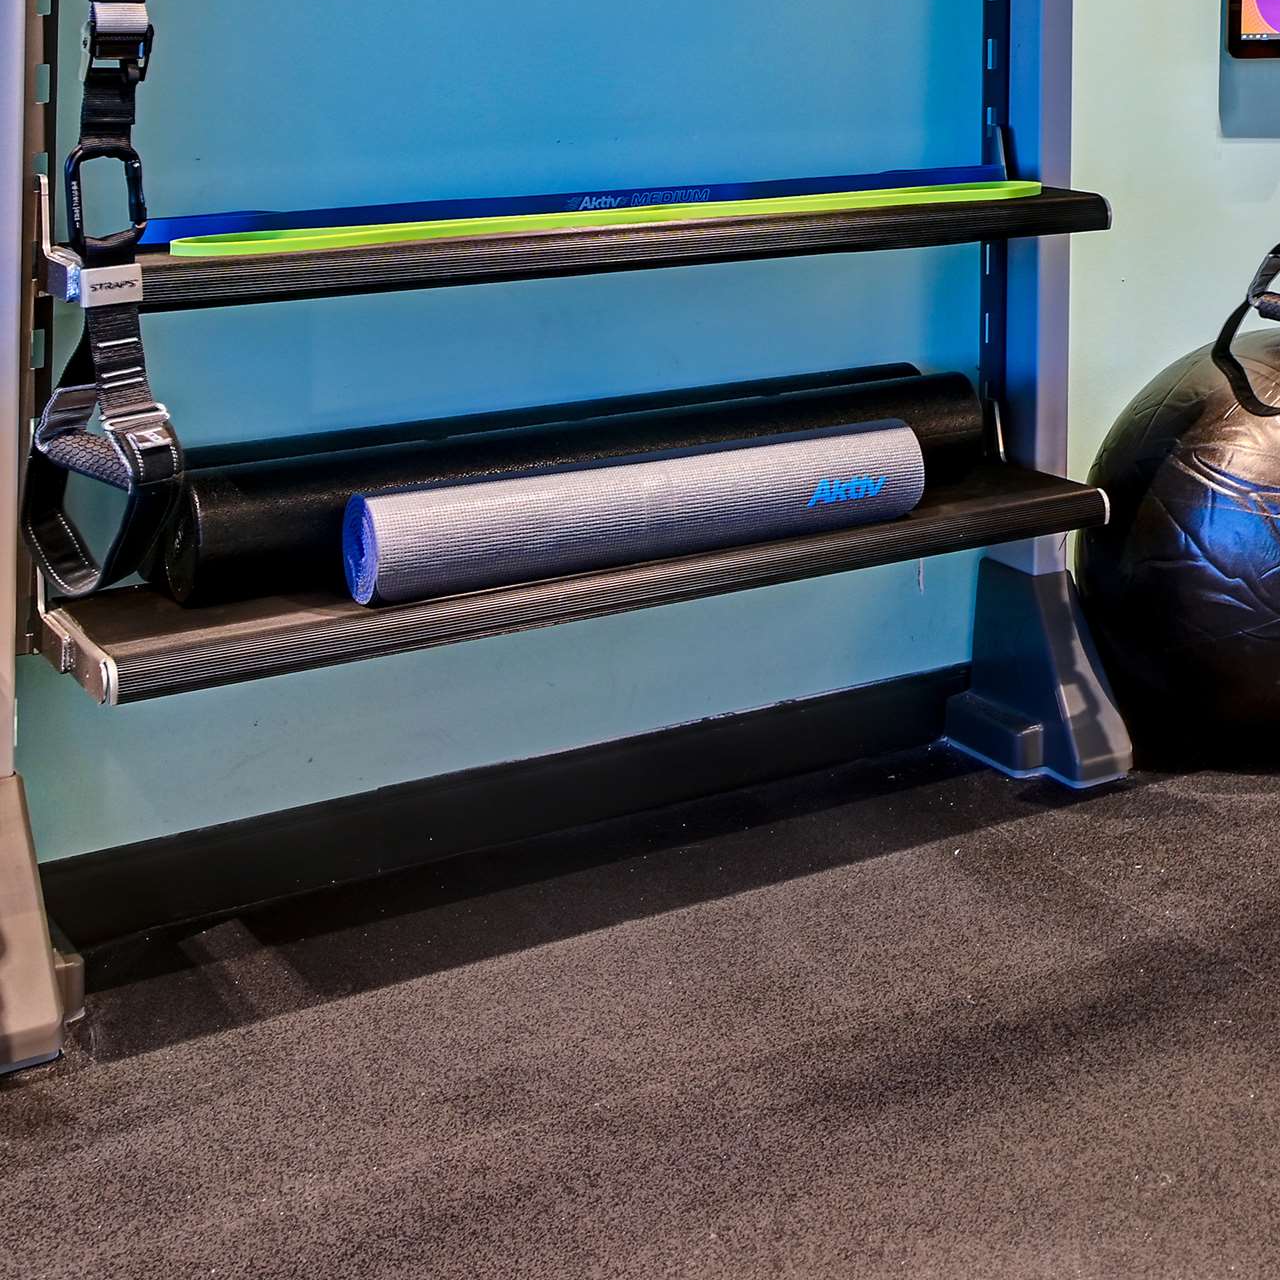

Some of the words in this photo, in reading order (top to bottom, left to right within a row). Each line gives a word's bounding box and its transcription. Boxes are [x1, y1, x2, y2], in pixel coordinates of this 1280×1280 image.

[578, 195, 623, 211] Aktiv
[630, 188, 711, 207] MEDIUM
[89, 279, 139, 293] STRAPS
[807, 474, 888, 508] Aktiv
